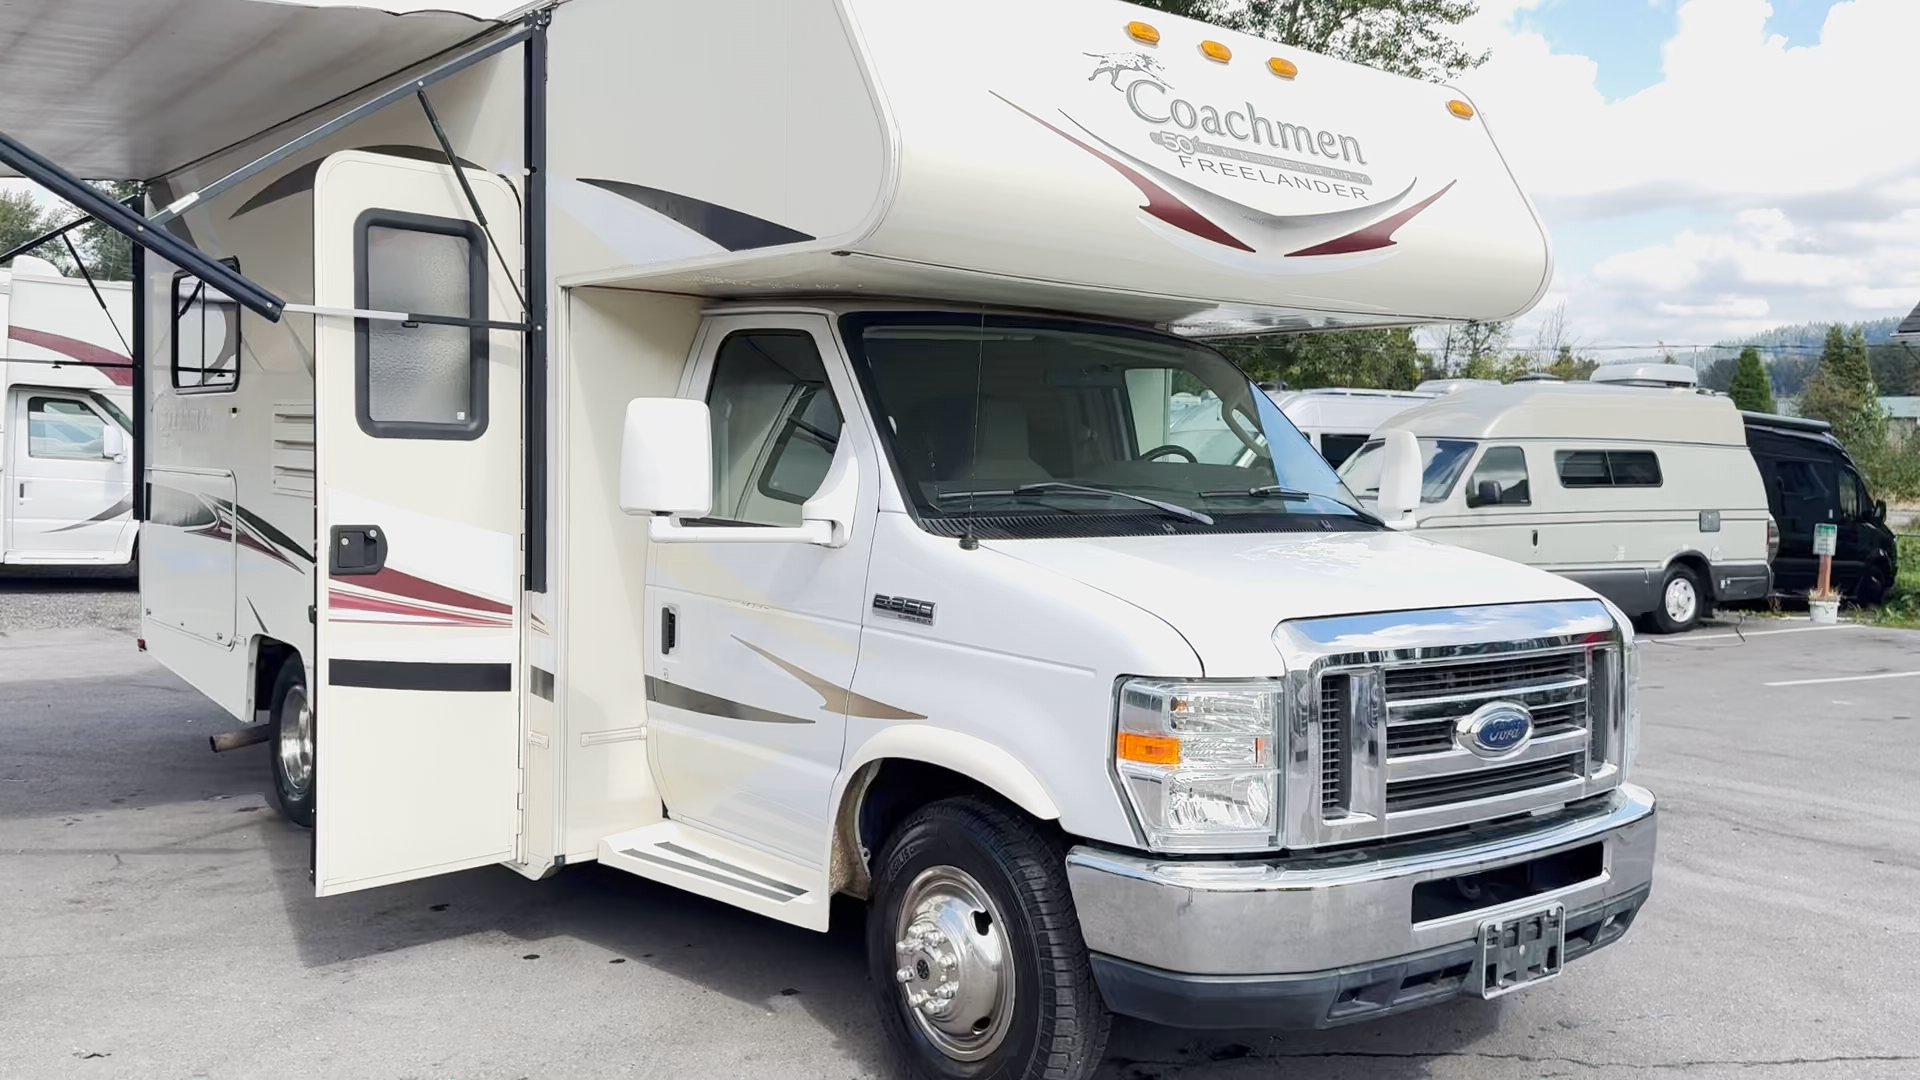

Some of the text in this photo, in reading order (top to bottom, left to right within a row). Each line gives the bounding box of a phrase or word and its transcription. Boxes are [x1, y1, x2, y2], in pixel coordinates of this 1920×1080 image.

[1126, 79, 1368, 165] Coachmen
[1178, 155, 1369, 201] FREELANDER
[1489, 718, 1521, 741] Ford
